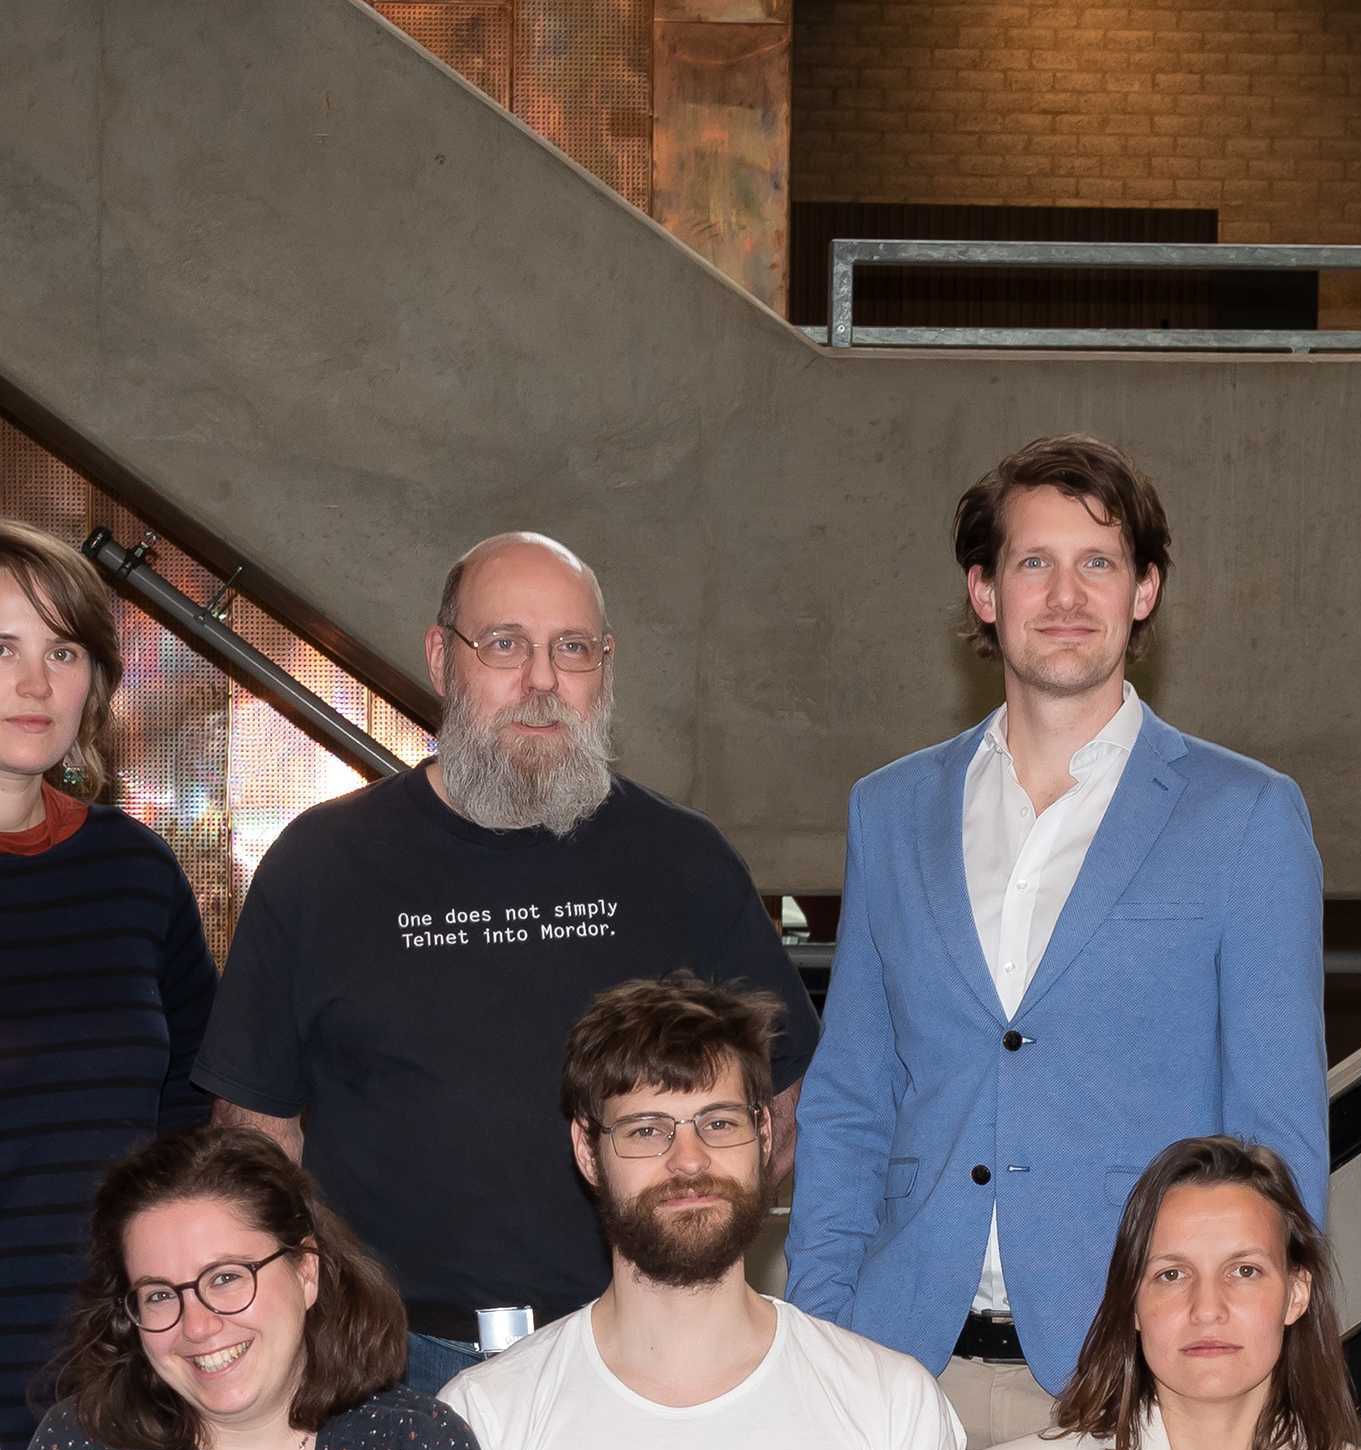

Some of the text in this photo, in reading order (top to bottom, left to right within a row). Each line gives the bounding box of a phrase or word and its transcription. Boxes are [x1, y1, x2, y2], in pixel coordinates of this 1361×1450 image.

[398, 899, 618, 929] One does not simply
[402, 921, 617, 949] Telnet into Mordor.
